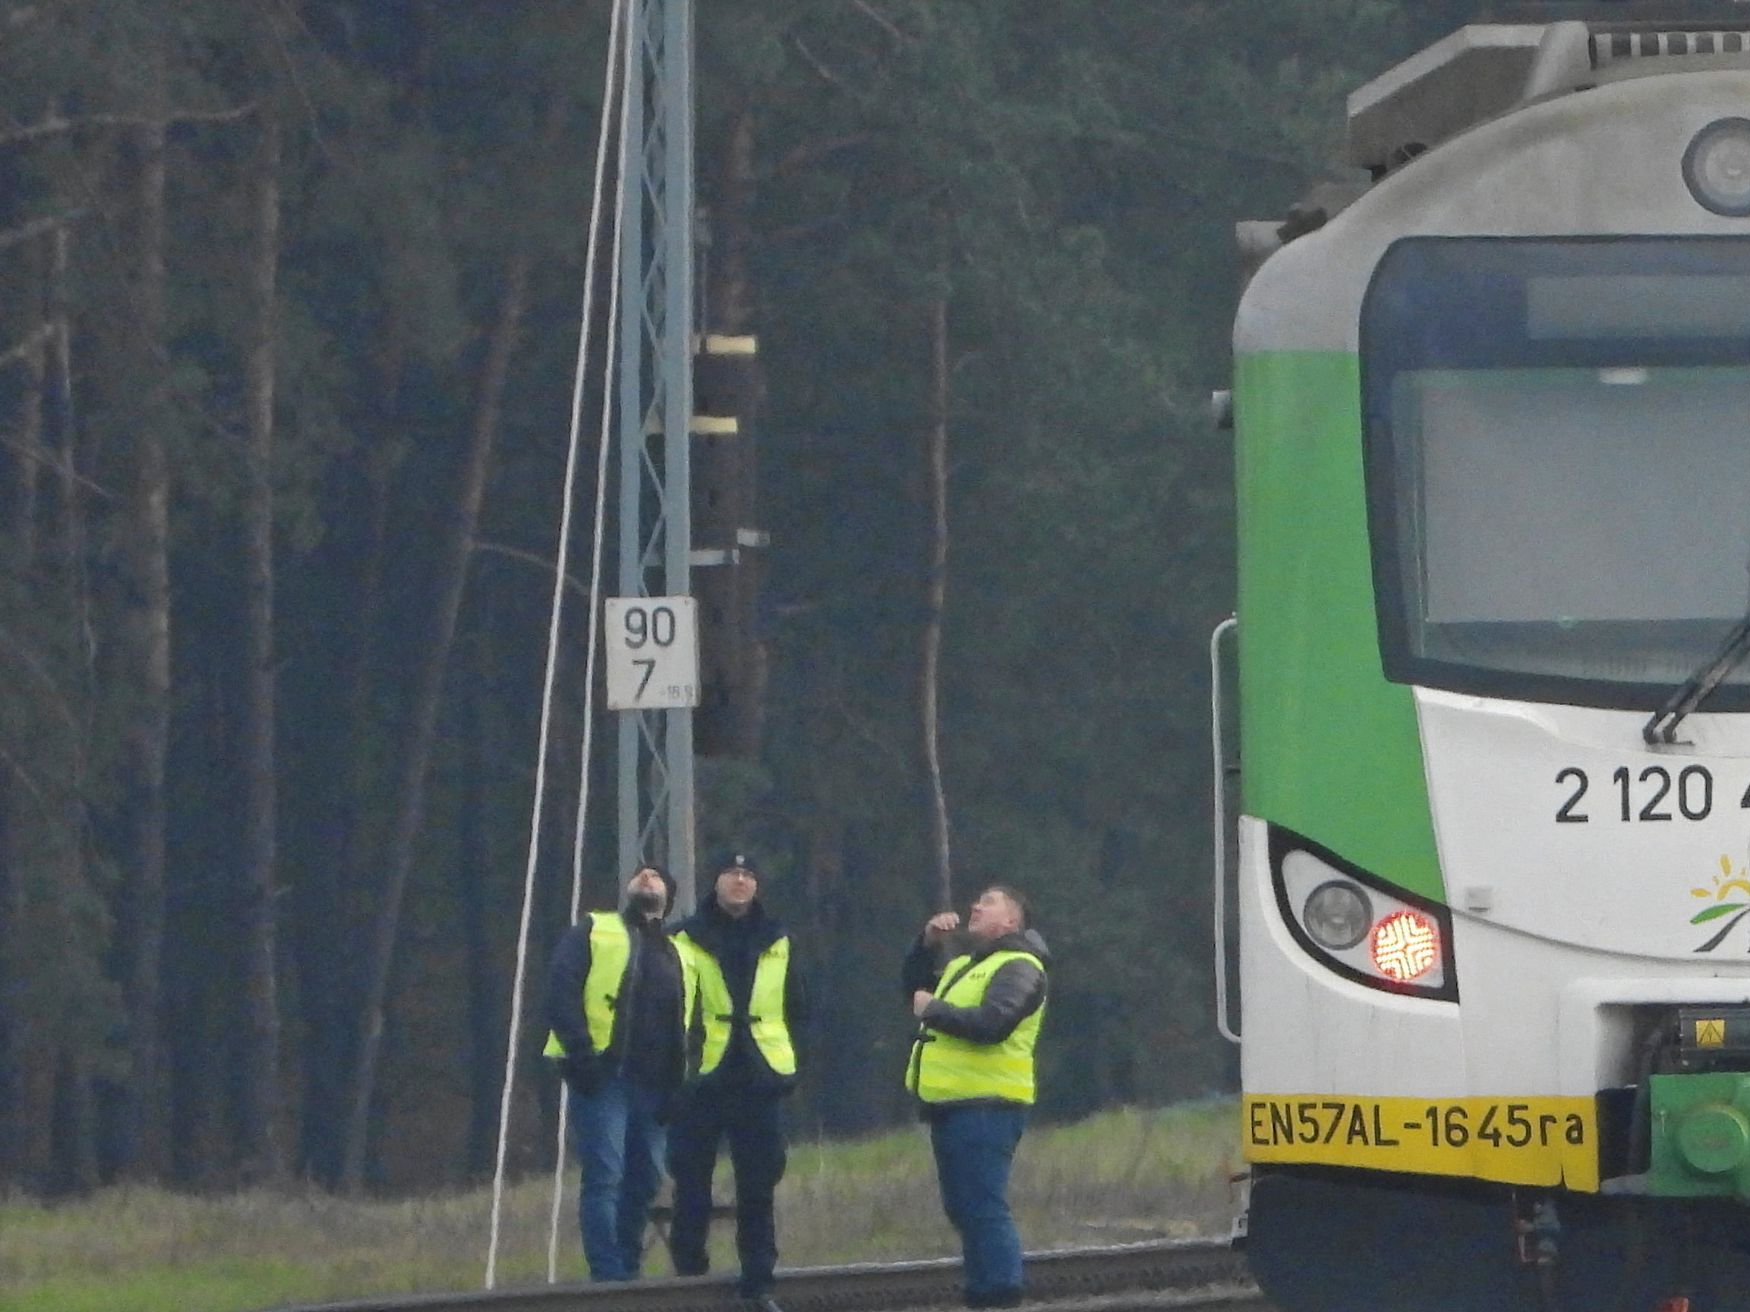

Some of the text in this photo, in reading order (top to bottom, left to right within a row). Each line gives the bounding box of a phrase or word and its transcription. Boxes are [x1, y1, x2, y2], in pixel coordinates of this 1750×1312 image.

[624, 606, 676, 649] 90
[632, 658, 656, 702] 7
[1555, 766, 1589, 823] 2
[1612, 763, 1713, 822] 120
